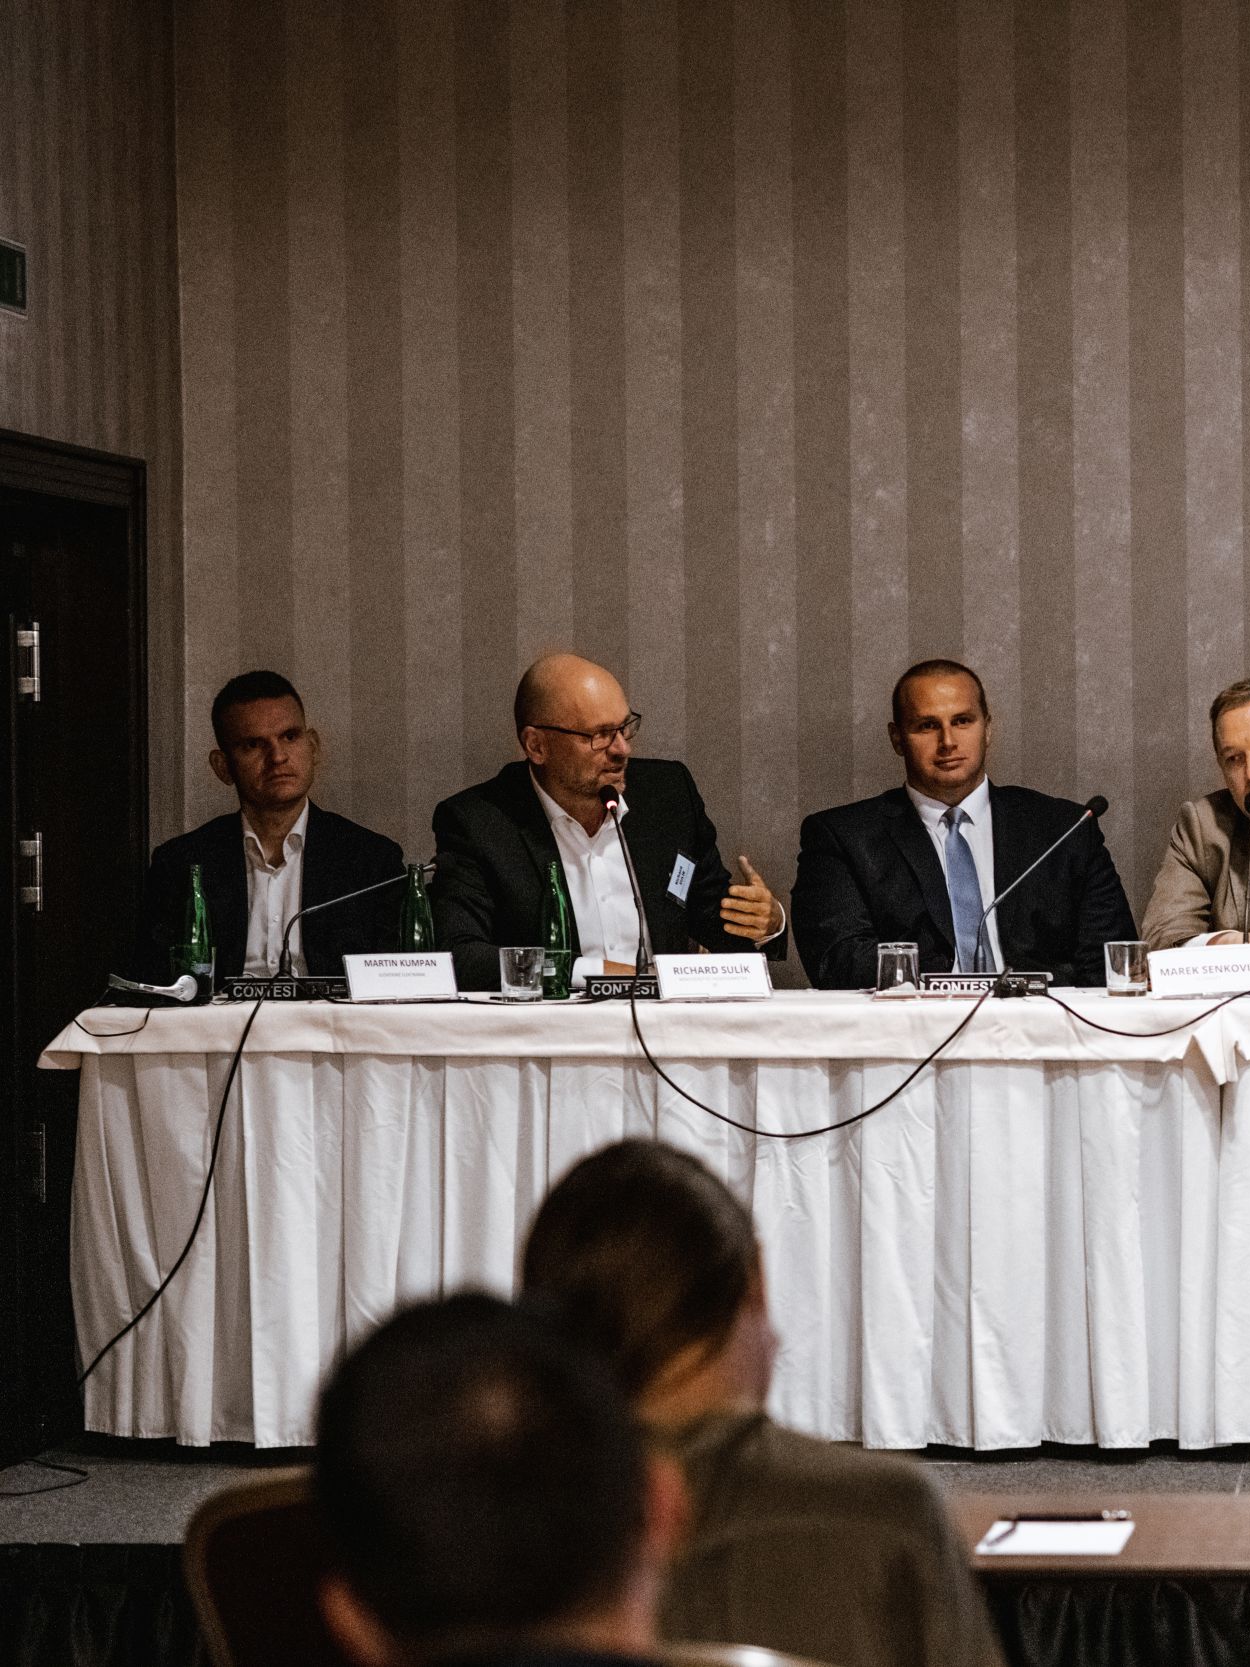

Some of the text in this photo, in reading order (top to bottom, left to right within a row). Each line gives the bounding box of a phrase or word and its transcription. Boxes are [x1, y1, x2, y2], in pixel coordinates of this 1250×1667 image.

[364, 959, 437, 968] MARTIN KUMPAN
[673, 965, 718, 975] RICHARD
[1159, 966, 1199, 977] MAREK
